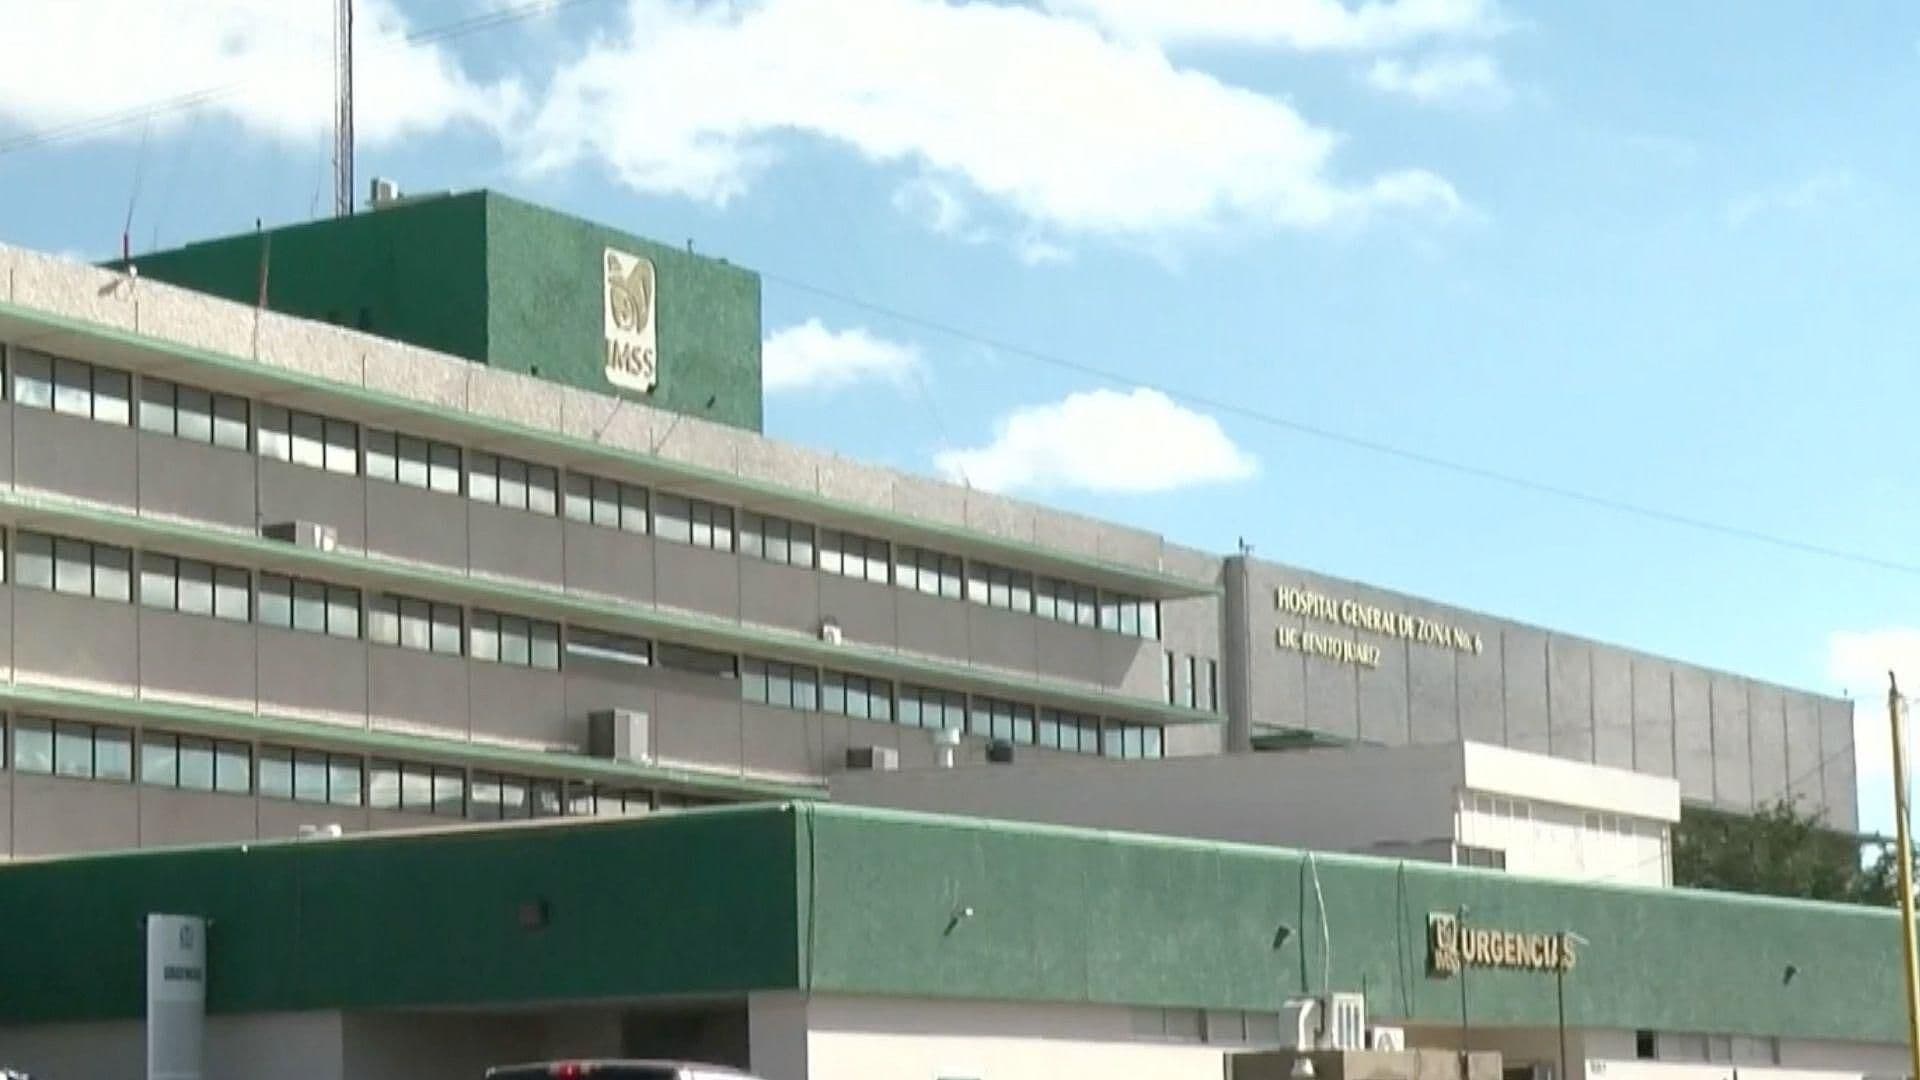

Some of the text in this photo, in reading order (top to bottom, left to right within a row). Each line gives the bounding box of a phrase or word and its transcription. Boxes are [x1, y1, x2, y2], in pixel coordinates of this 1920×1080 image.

[604, 338, 653, 378] IMSS
[1276, 584, 1339, 625] HOSPITAL
[1341, 598, 1397, 637] GENERAL
[1398, 611, 1415, 640] DE
[1416, 615, 1452, 648] ZONA
[1474, 631, 1484, 656] 6
